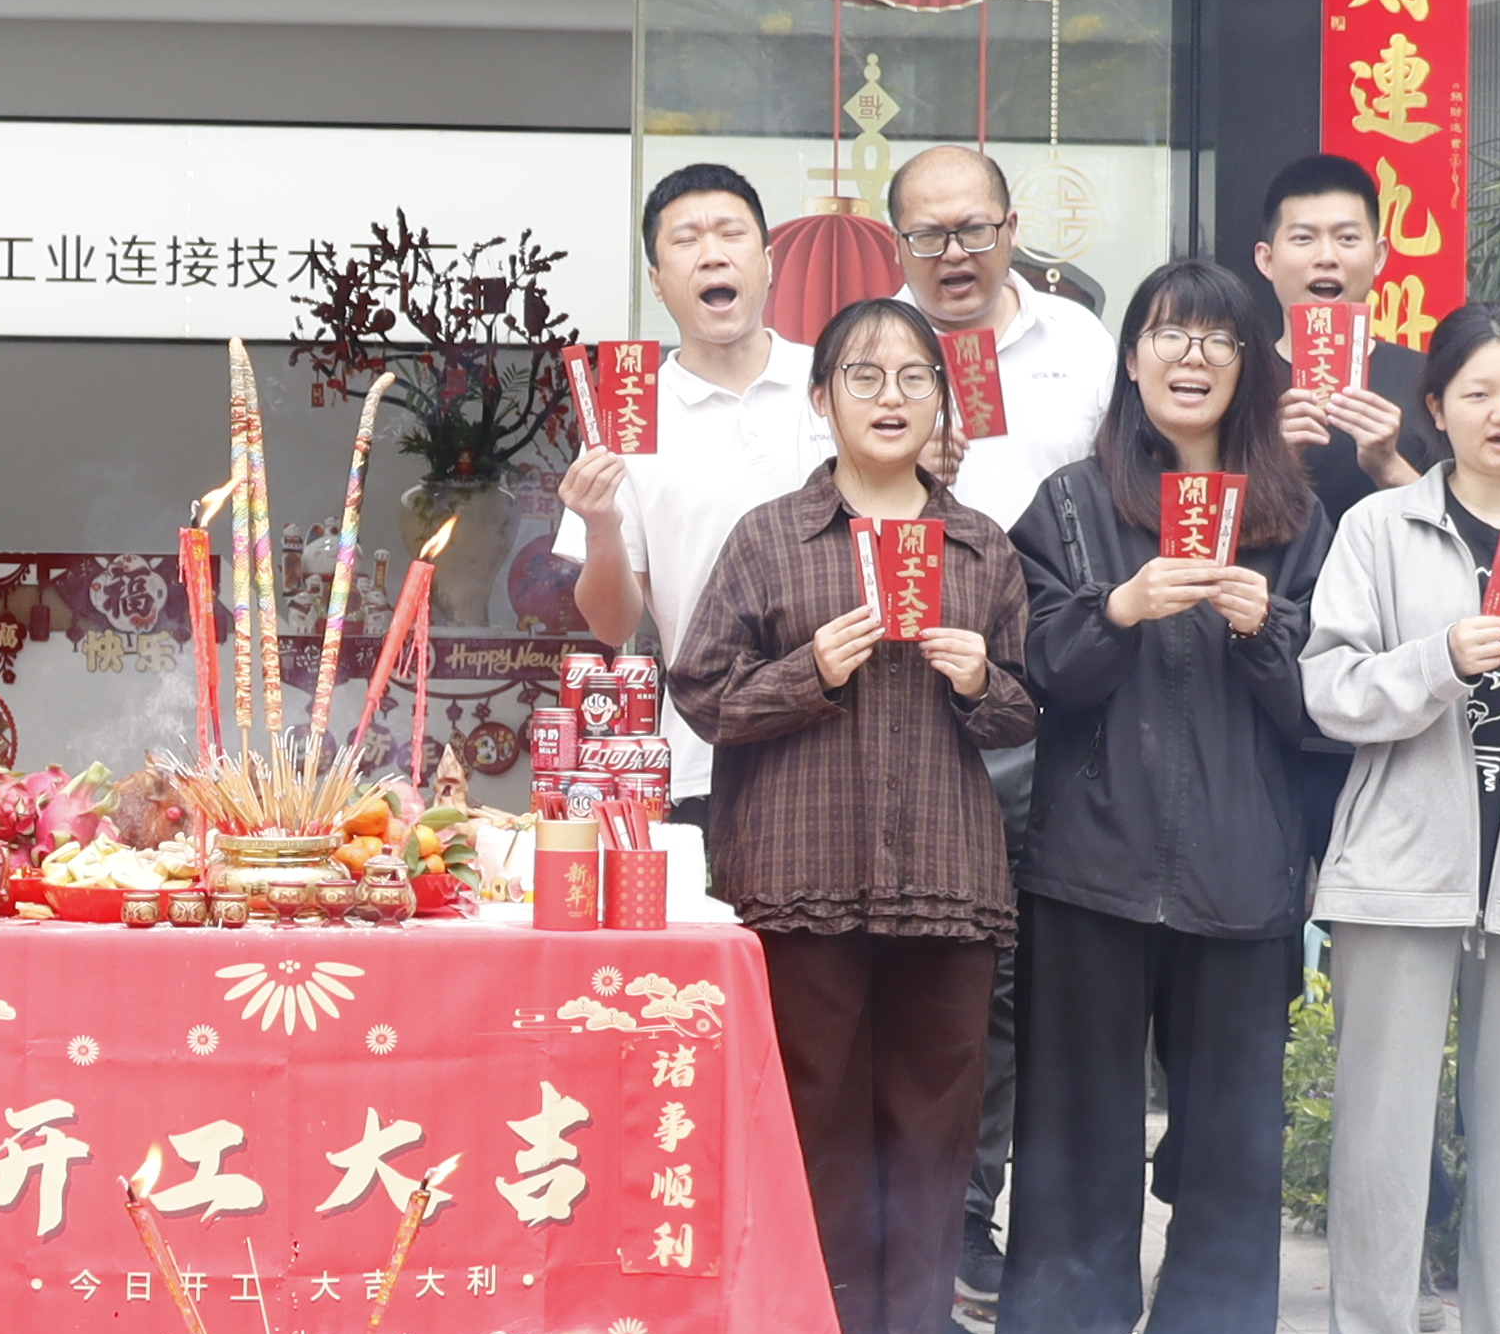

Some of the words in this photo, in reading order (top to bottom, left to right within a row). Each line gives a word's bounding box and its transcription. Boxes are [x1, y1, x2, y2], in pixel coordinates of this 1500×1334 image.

[614, 343, 648, 453] 開工大吉
[953, 332, 994, 437] 開工大吉
[1177, 476, 1211, 559] 開工大
[102, 567, 155, 619] 福
[896, 523, 929, 638] 開工大吉
[82, 629, 177, 673] 快乐
[445, 642, 512, 677] Happy
[513, 641, 562, 671] New
[563, 861, 589, 910] 新年
[648, 1043, 697, 1267] 诸事顺利
[69, 1267, 262, 1303] 今日开工
[310, 1263, 498, 1302] 大吉大利
